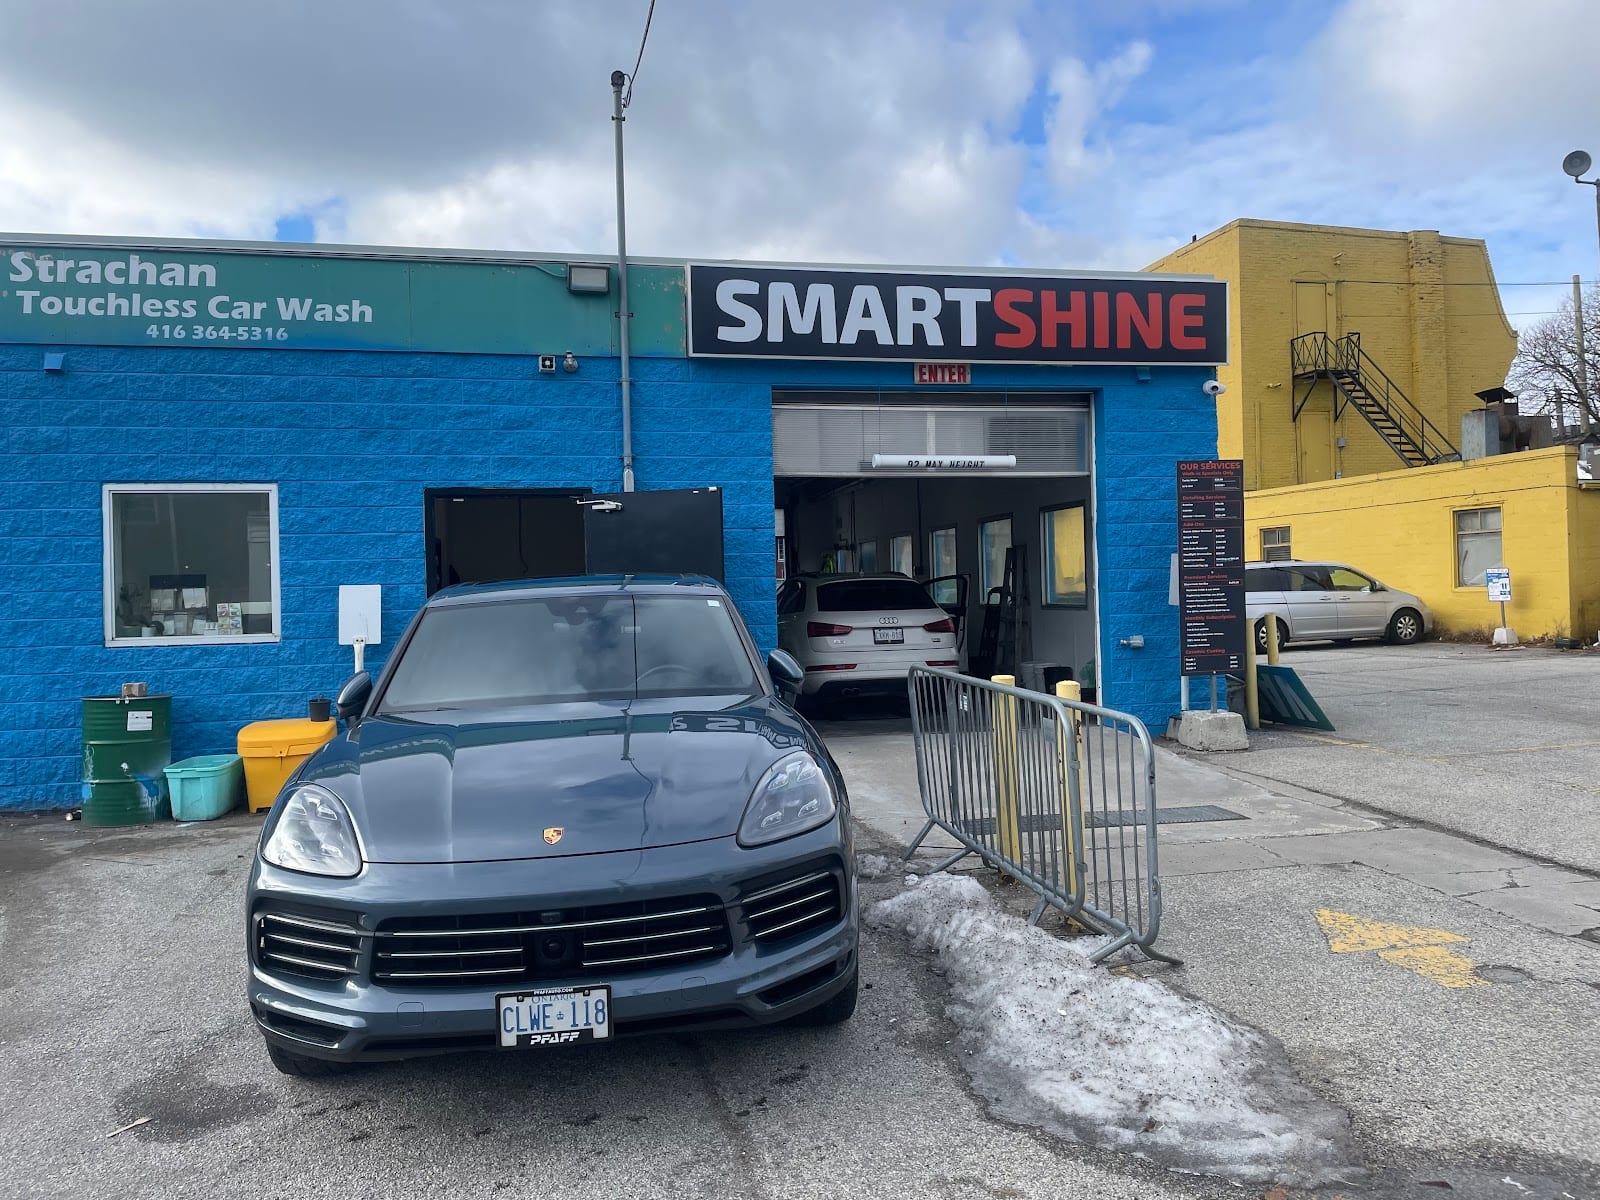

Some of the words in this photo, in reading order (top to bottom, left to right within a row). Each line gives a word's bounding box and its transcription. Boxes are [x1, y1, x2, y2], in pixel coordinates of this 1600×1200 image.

[9, 251, 217, 287] Strachan
[15, 290, 197, 318] Touchless
[207, 295, 267, 320] Car
[276, 297, 373, 323] Wash
[715, 278, 1207, 350] SMARTSHINE
[146, 324, 186, 340] 416
[191, 325, 289, 342] 364-5316
[918, 364, 968, 384] ENTER
[907, 460, 920, 468] 92
[949, 460, 985, 468] HEIGHT
[1200, 462, 1241, 470] SERVICES
[531, 992, 577, 1004] ONTARIO
[502, 1003, 554, 1034] CLWE
[570, 998, 606, 1028] 118
[530, 1031, 580, 1045] PFAFF
